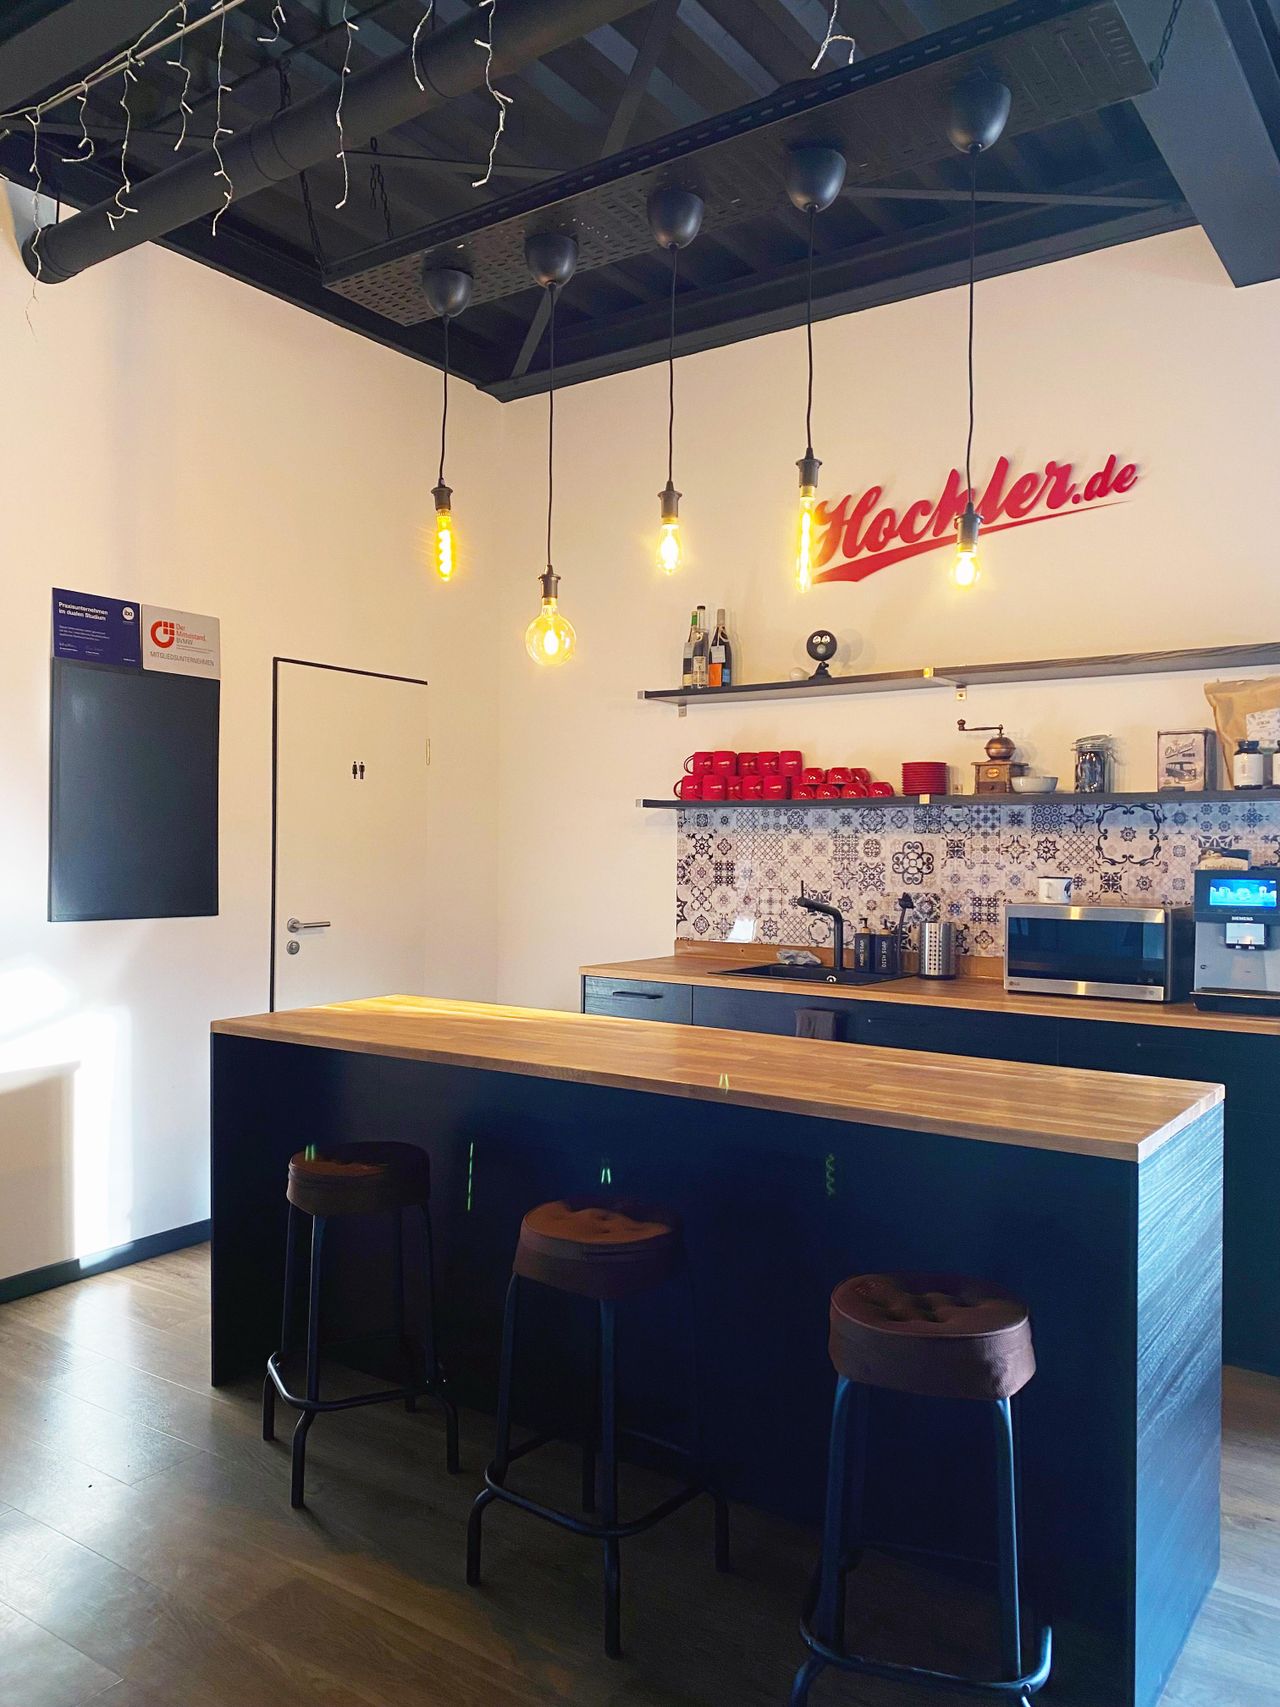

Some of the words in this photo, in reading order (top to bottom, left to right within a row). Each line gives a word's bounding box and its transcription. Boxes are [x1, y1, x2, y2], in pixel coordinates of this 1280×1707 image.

[814, 454, 1138, 567] Hochler.de
[58, 602, 109, 614] Praxisunternehmen
[85, 613, 106, 621] Studium
